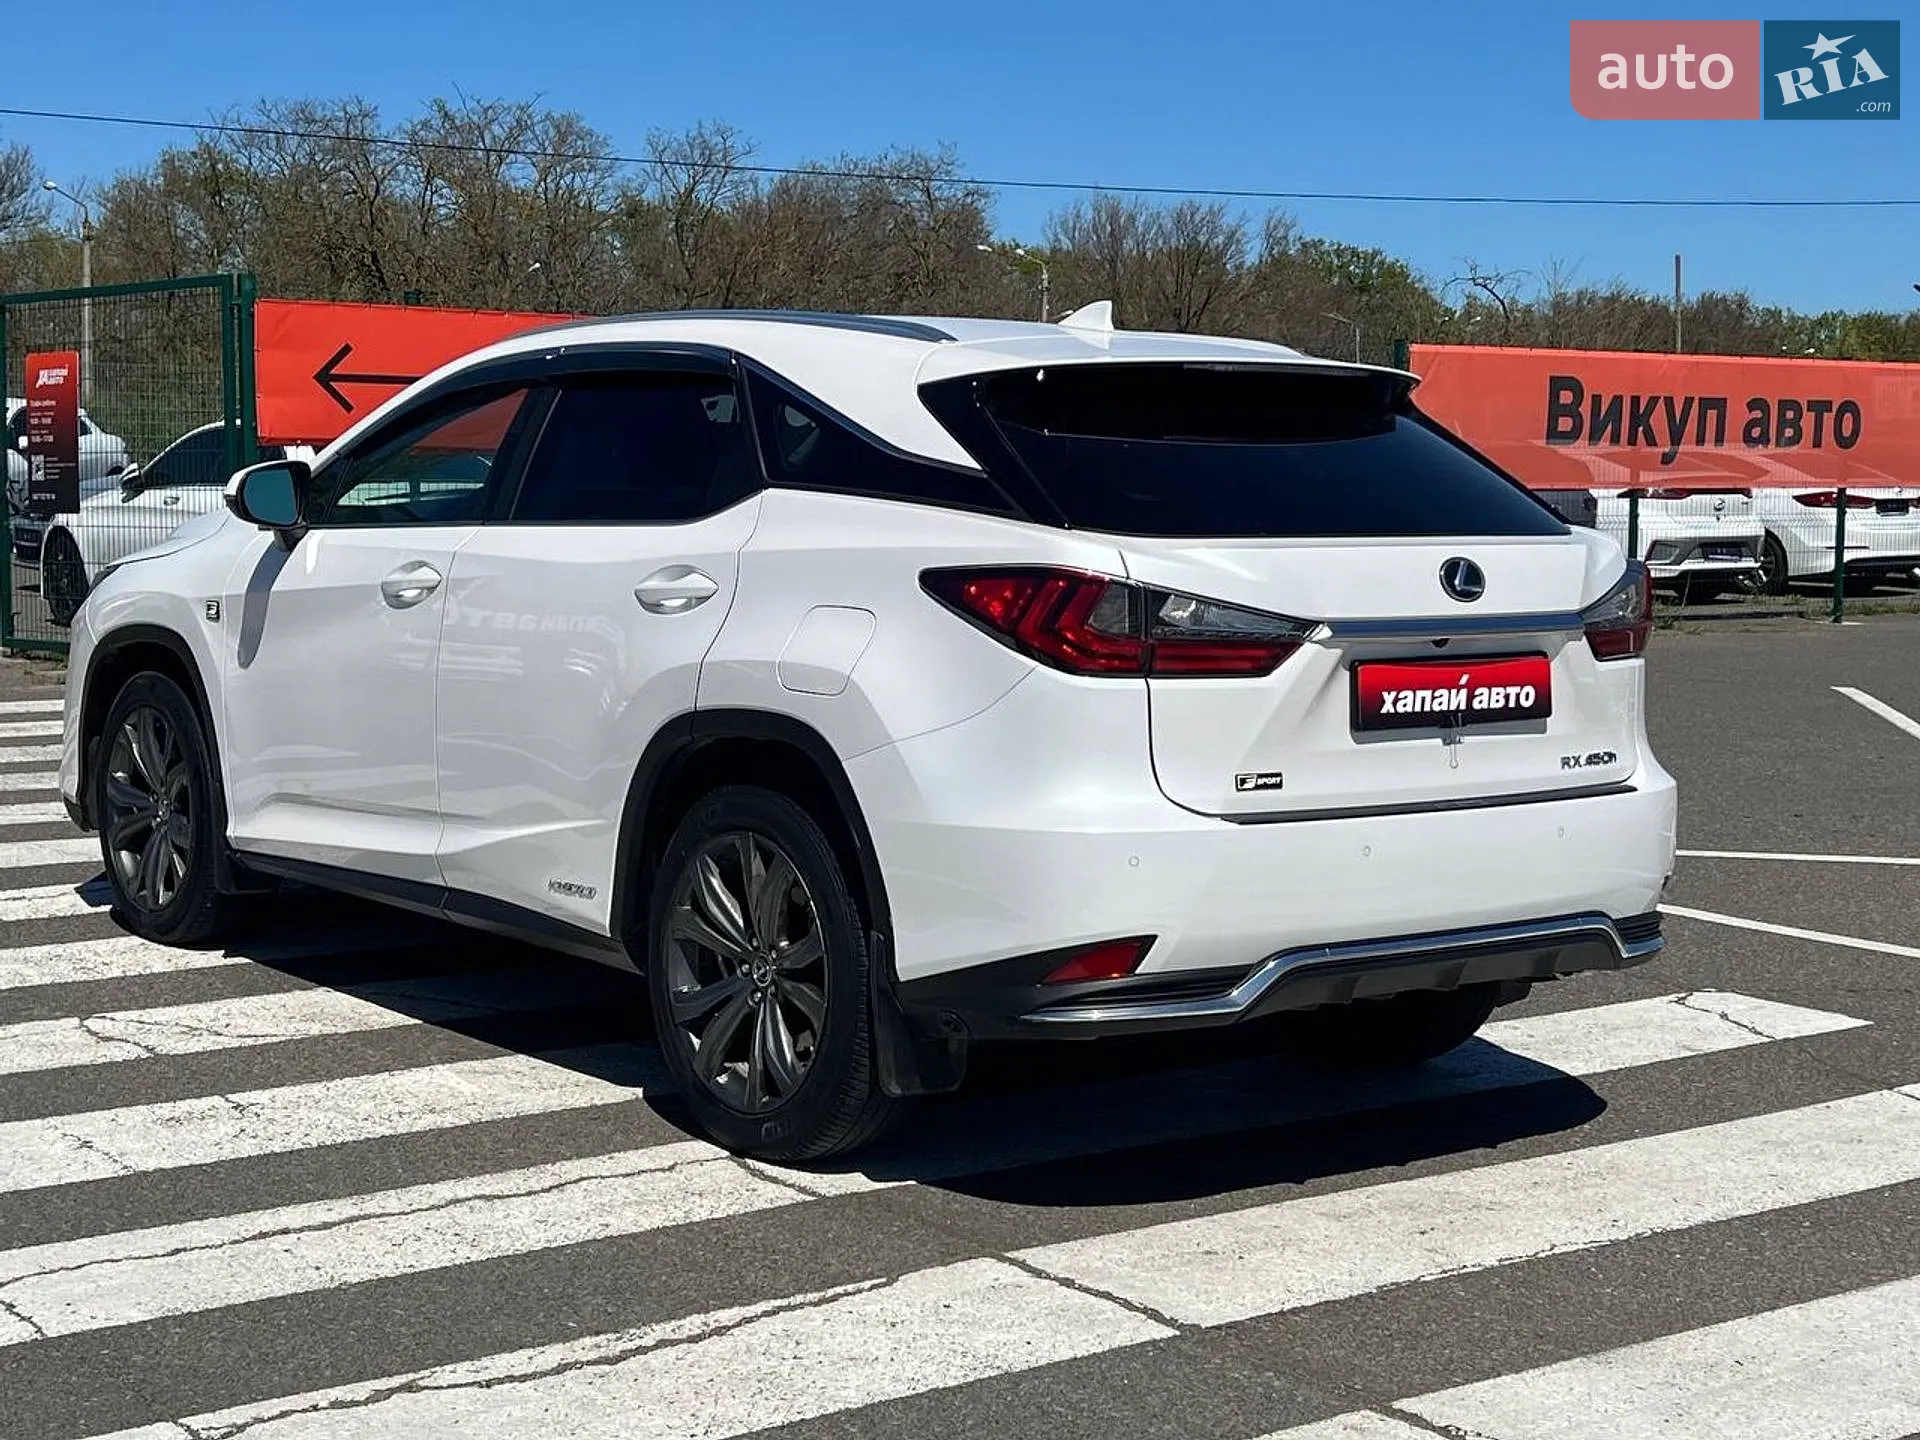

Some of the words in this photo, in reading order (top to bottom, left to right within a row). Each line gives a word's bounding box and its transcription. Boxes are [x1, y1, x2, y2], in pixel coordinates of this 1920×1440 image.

[1546, 376, 1727, 465] Викуп
[1742, 398, 1862, 450] авто
[1472, 685, 1536, 710] авто
[1560, 754, 1582, 770] RX
